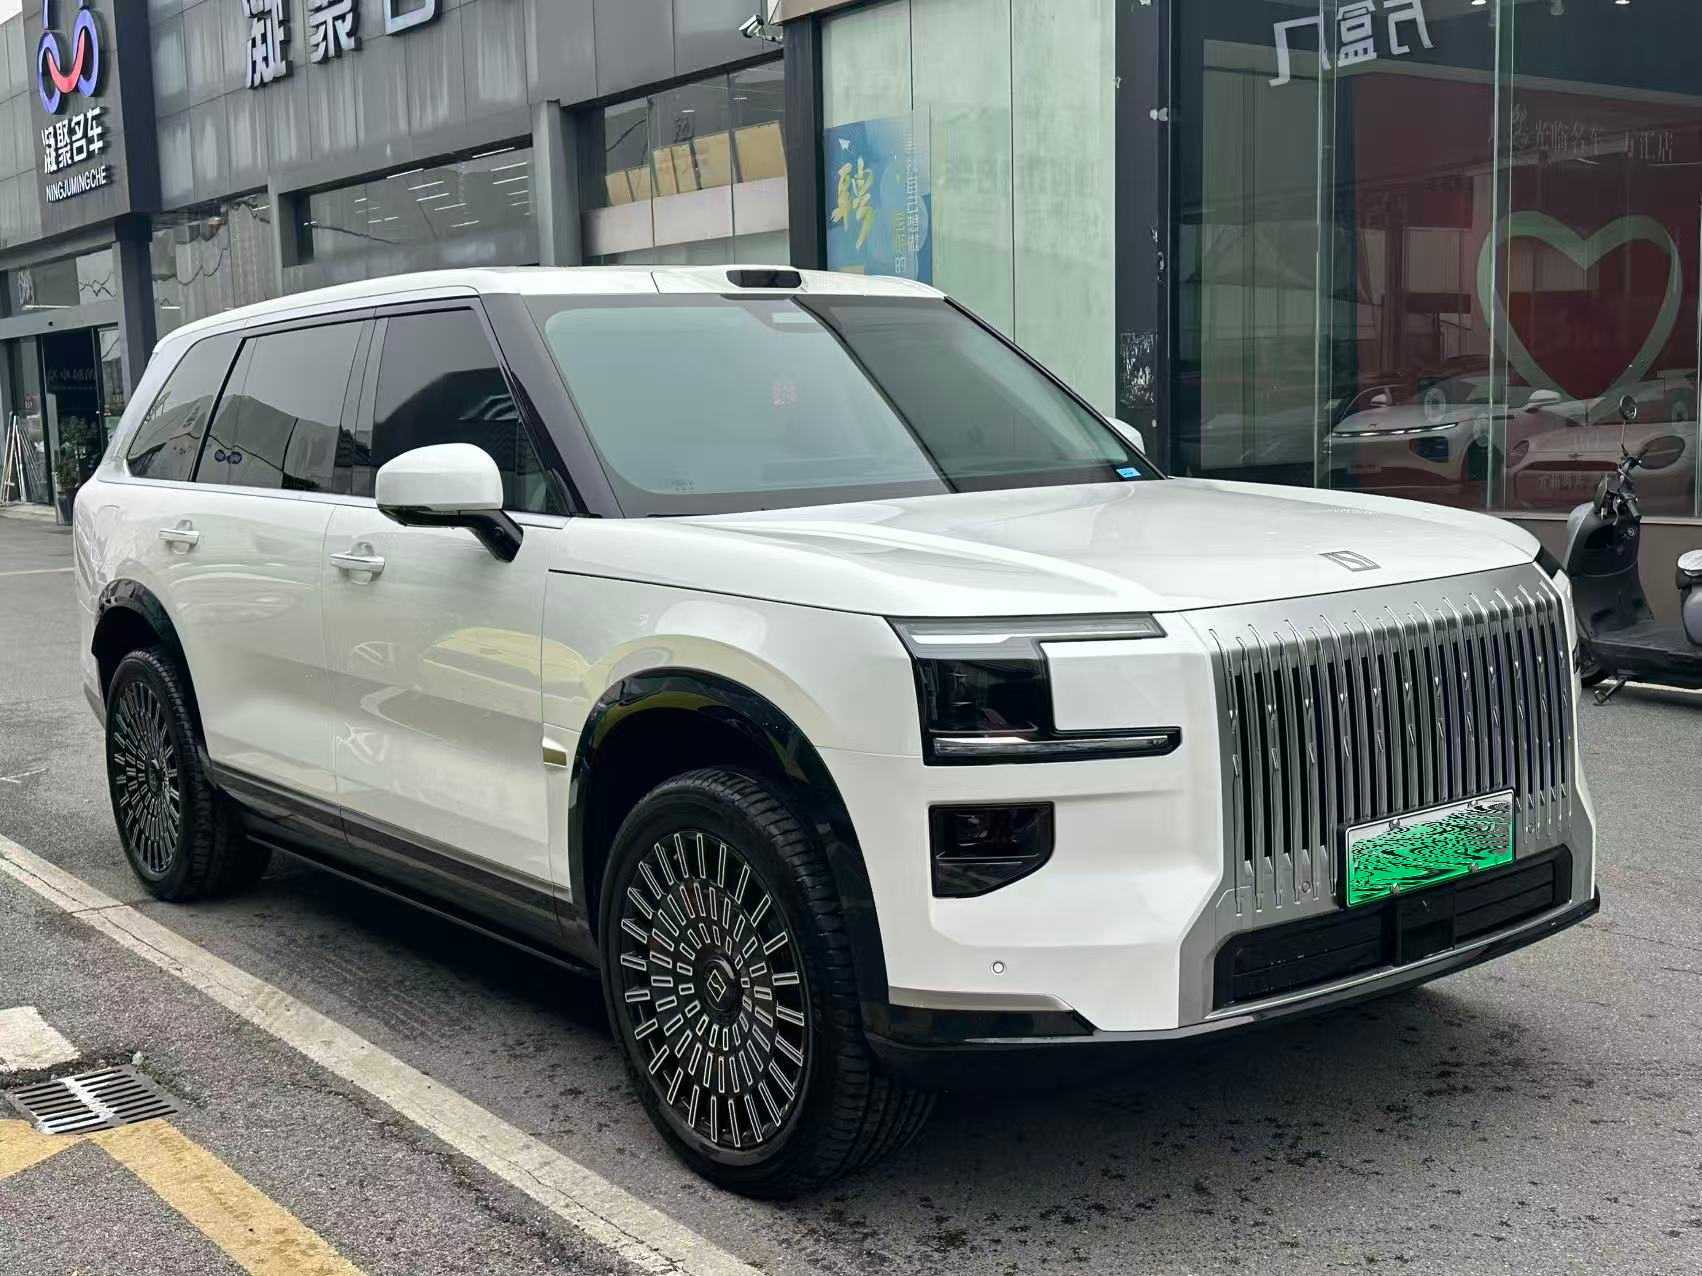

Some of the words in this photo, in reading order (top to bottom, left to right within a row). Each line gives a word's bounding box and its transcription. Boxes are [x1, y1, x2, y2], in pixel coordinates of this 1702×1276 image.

[41, 107, 104, 174] 凝聚名车
[46, 165, 107, 203] NINGJUMINGCHE
